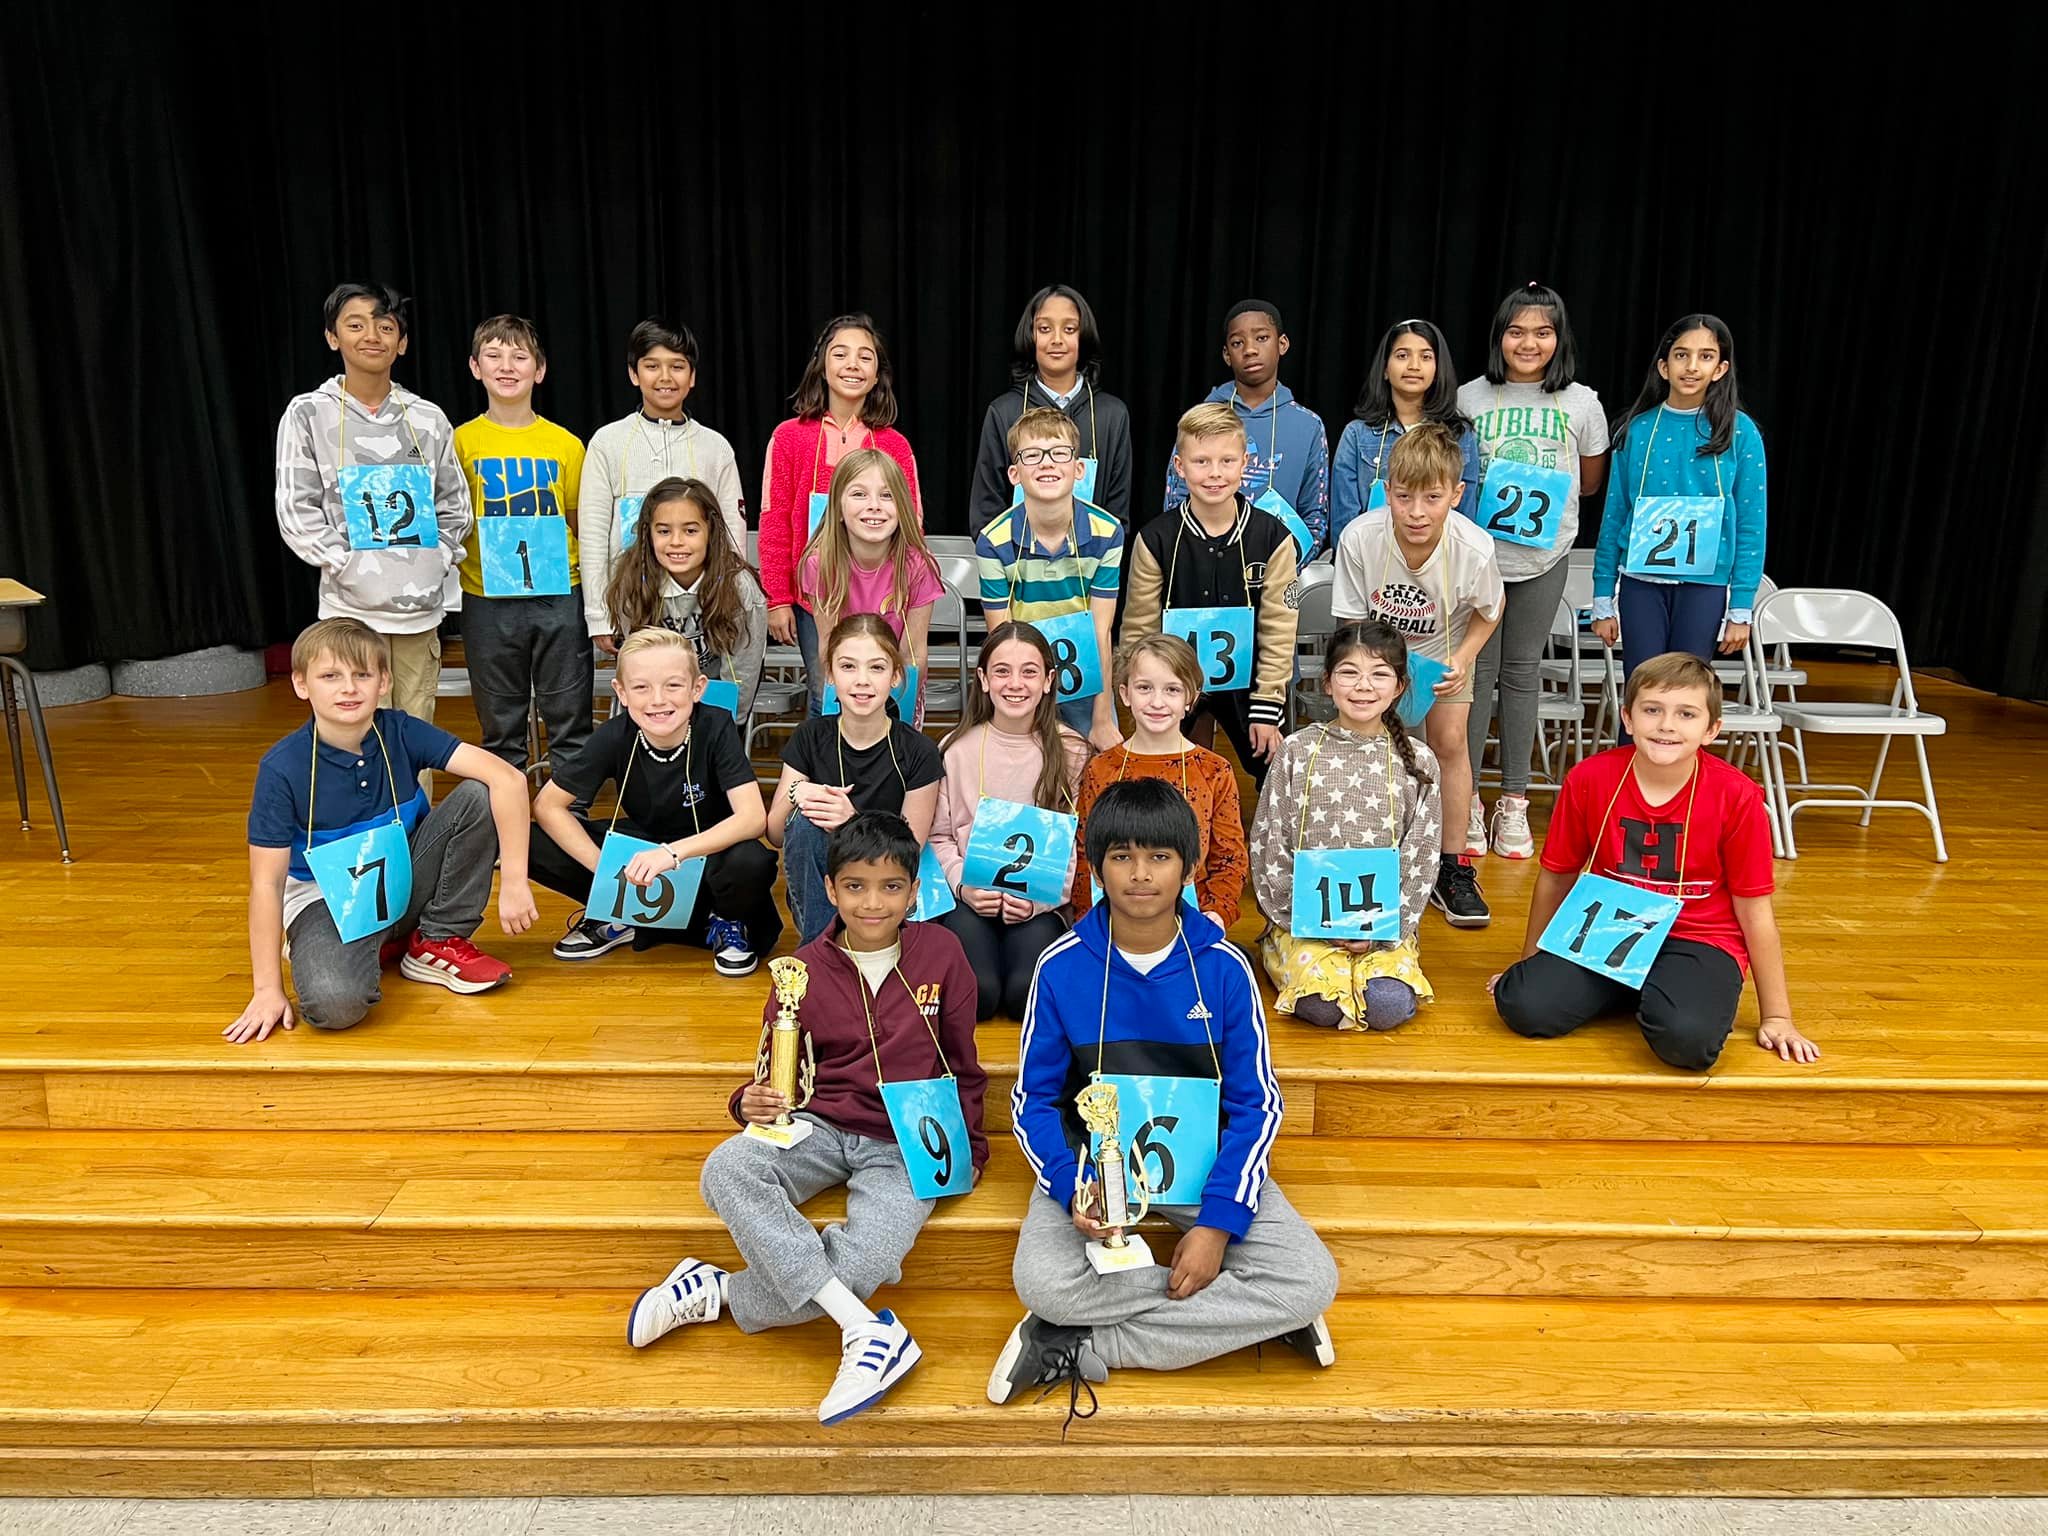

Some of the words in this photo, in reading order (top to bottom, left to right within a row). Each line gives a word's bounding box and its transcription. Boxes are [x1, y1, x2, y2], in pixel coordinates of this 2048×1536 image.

[361, 490, 422, 546] 12
[1486, 485, 1550, 538] 23
[515, 540, 534, 590] 1
[1644, 518, 1697, 567] 21
[1382, 590, 1427, 606] CALM
[1386, 584, 1427, 597] KEEP
[1394, 598, 1413, 607] AND
[1370, 609, 1436, 634] ASEBALL
[1050, 638, 1083, 695] 8
[992, 833, 1034, 893] 2
[1617, 817, 1684, 883] H
[347, 857, 388, 922] 7
[611, 865, 675, 924] 19
[1316, 874, 1383, 931] 14
[1569, 901, 1660, 970] 17
[918, 1116, 952, 1187] 9
[1128, 1116, 1179, 1194] 6
